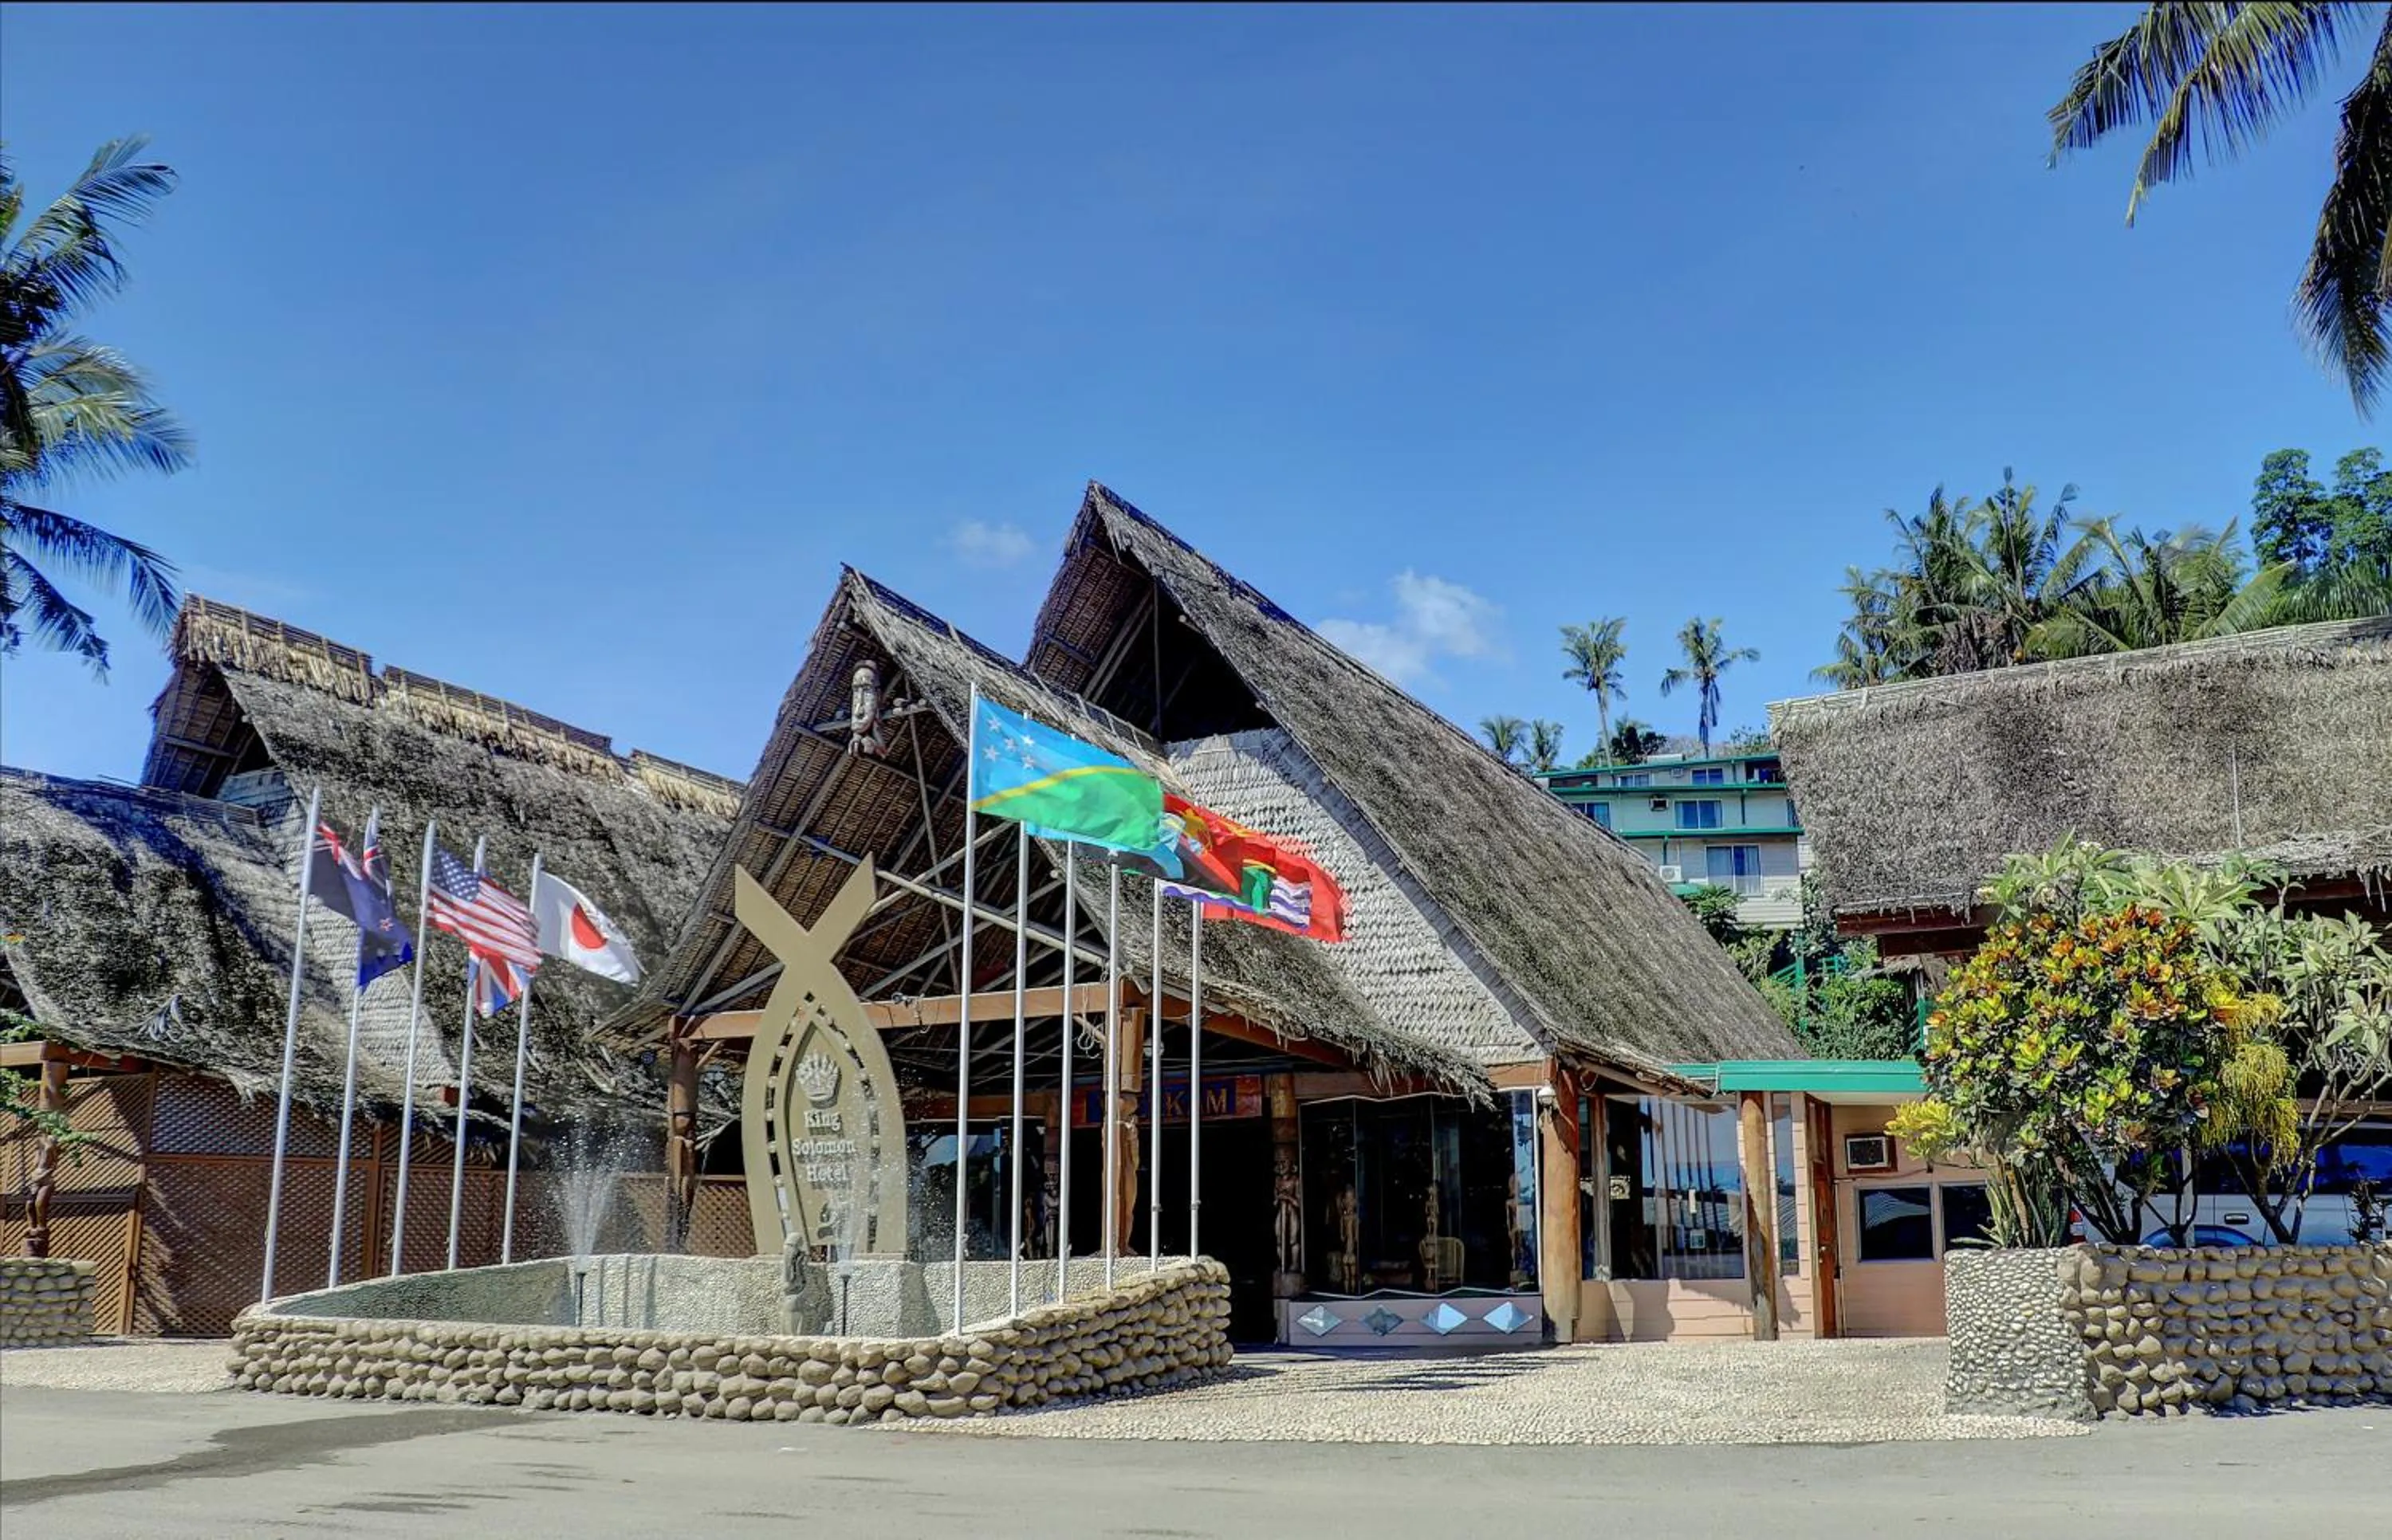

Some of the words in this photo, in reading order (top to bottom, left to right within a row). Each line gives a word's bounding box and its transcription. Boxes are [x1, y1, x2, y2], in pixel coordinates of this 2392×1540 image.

[804, 1110, 841, 1131] King
[792, 1138, 856, 1155] Solomon
[806, 1164, 848, 1181] Hotel
